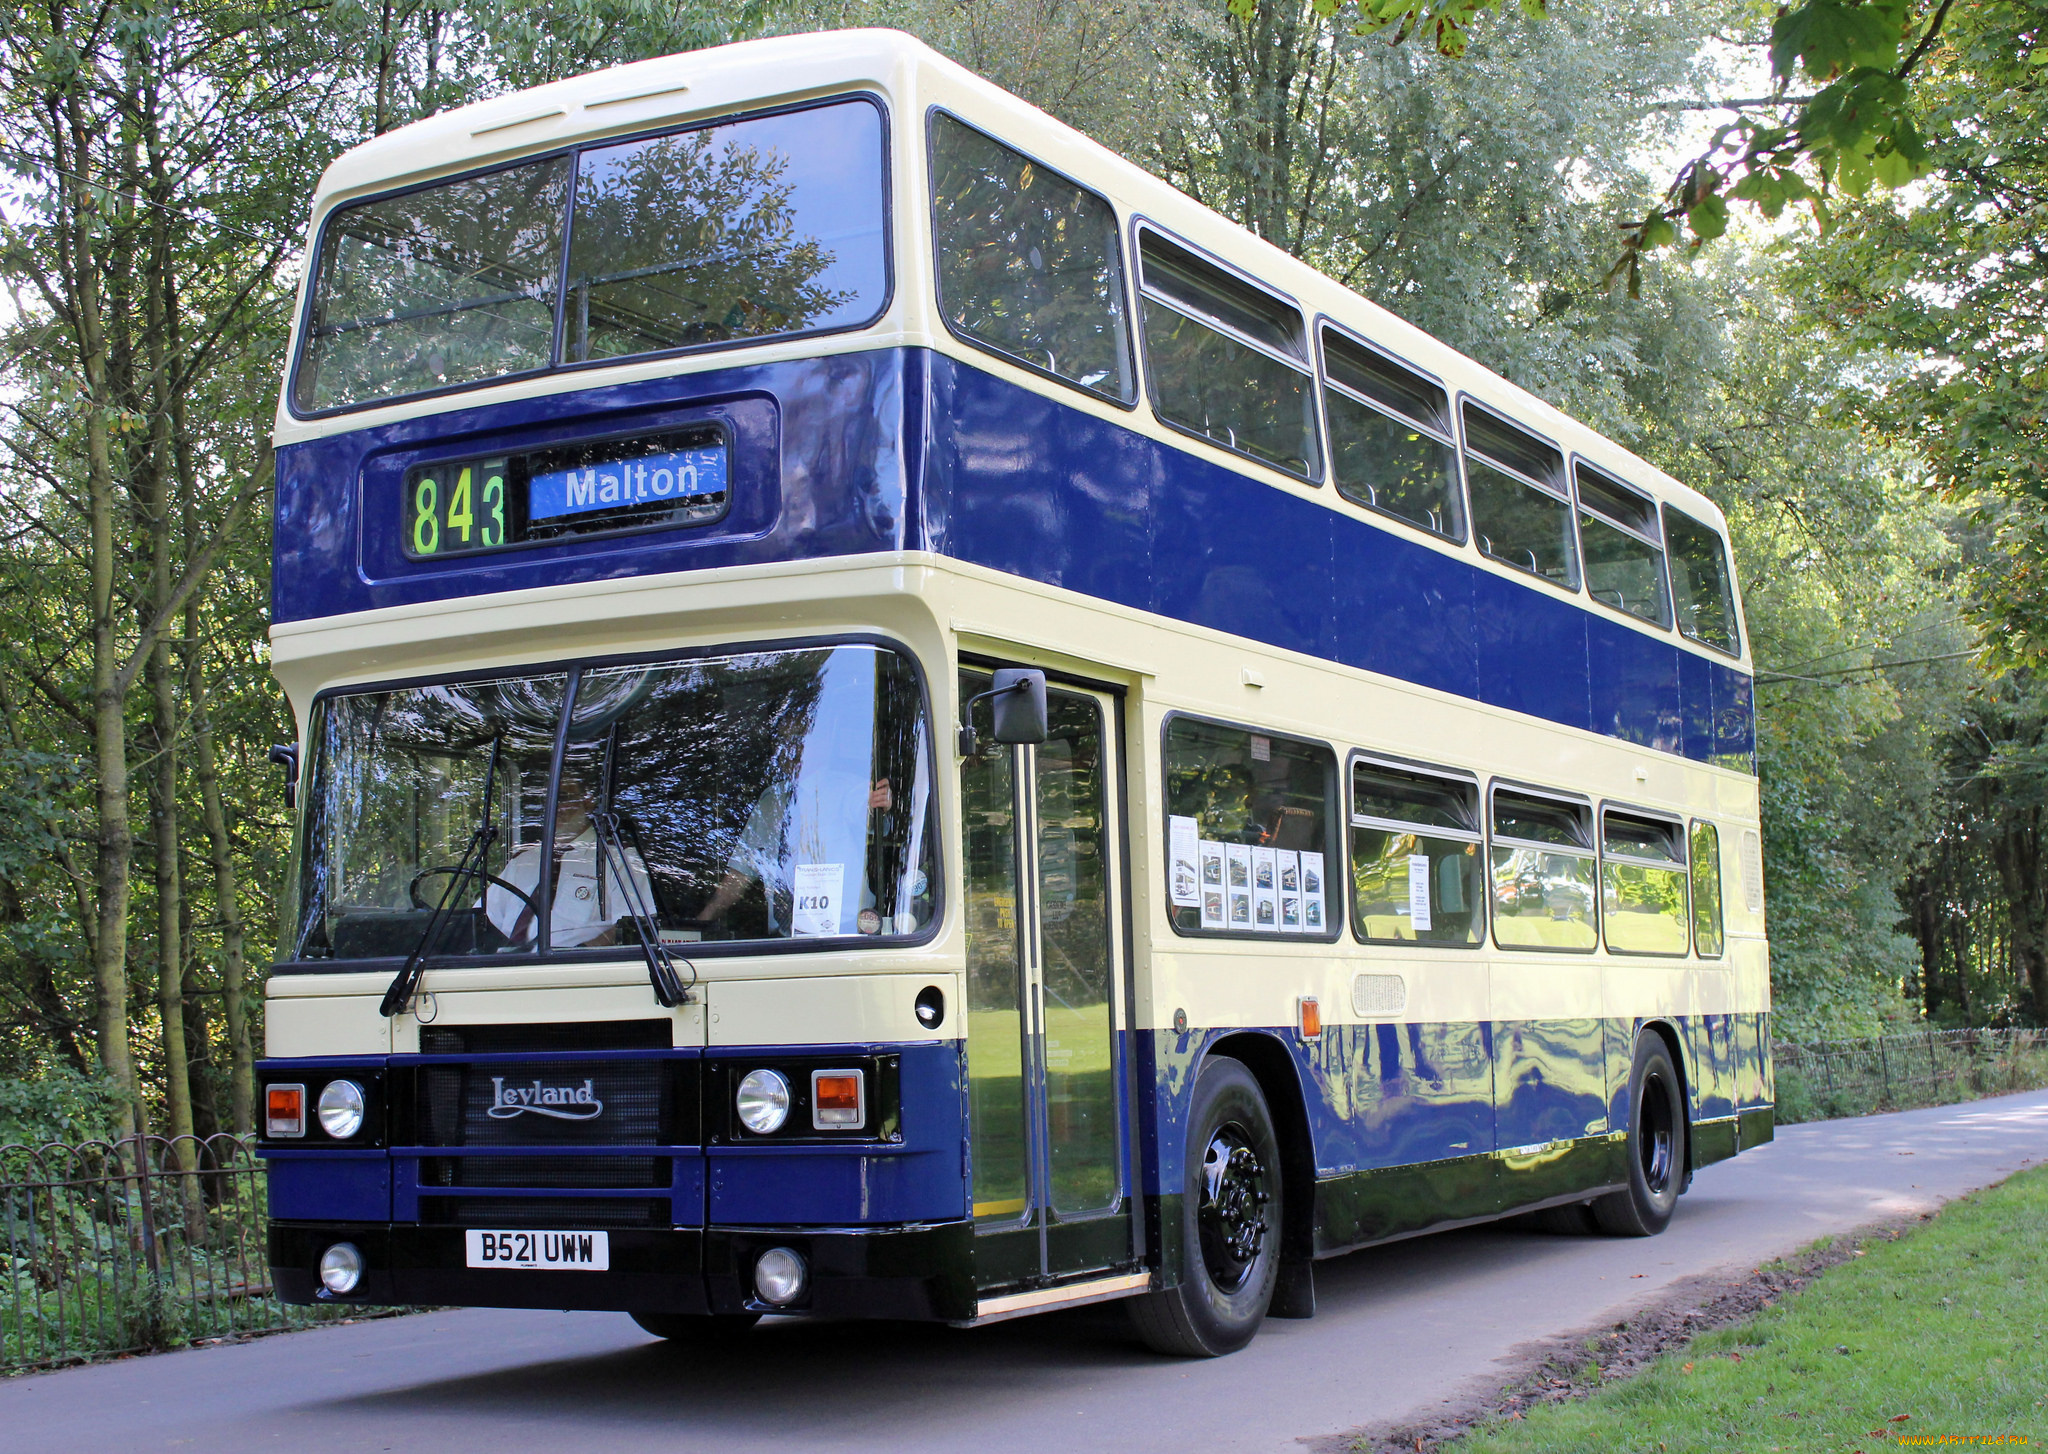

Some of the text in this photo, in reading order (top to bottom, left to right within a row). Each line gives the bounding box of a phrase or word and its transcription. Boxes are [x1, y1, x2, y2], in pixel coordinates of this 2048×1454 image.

[414, 463, 698, 554] 843 Malton
[799, 895, 829, 910] K10
[488, 1077, 603, 1119] Leyland
[482, 1233, 592, 1263] B521 UWW
